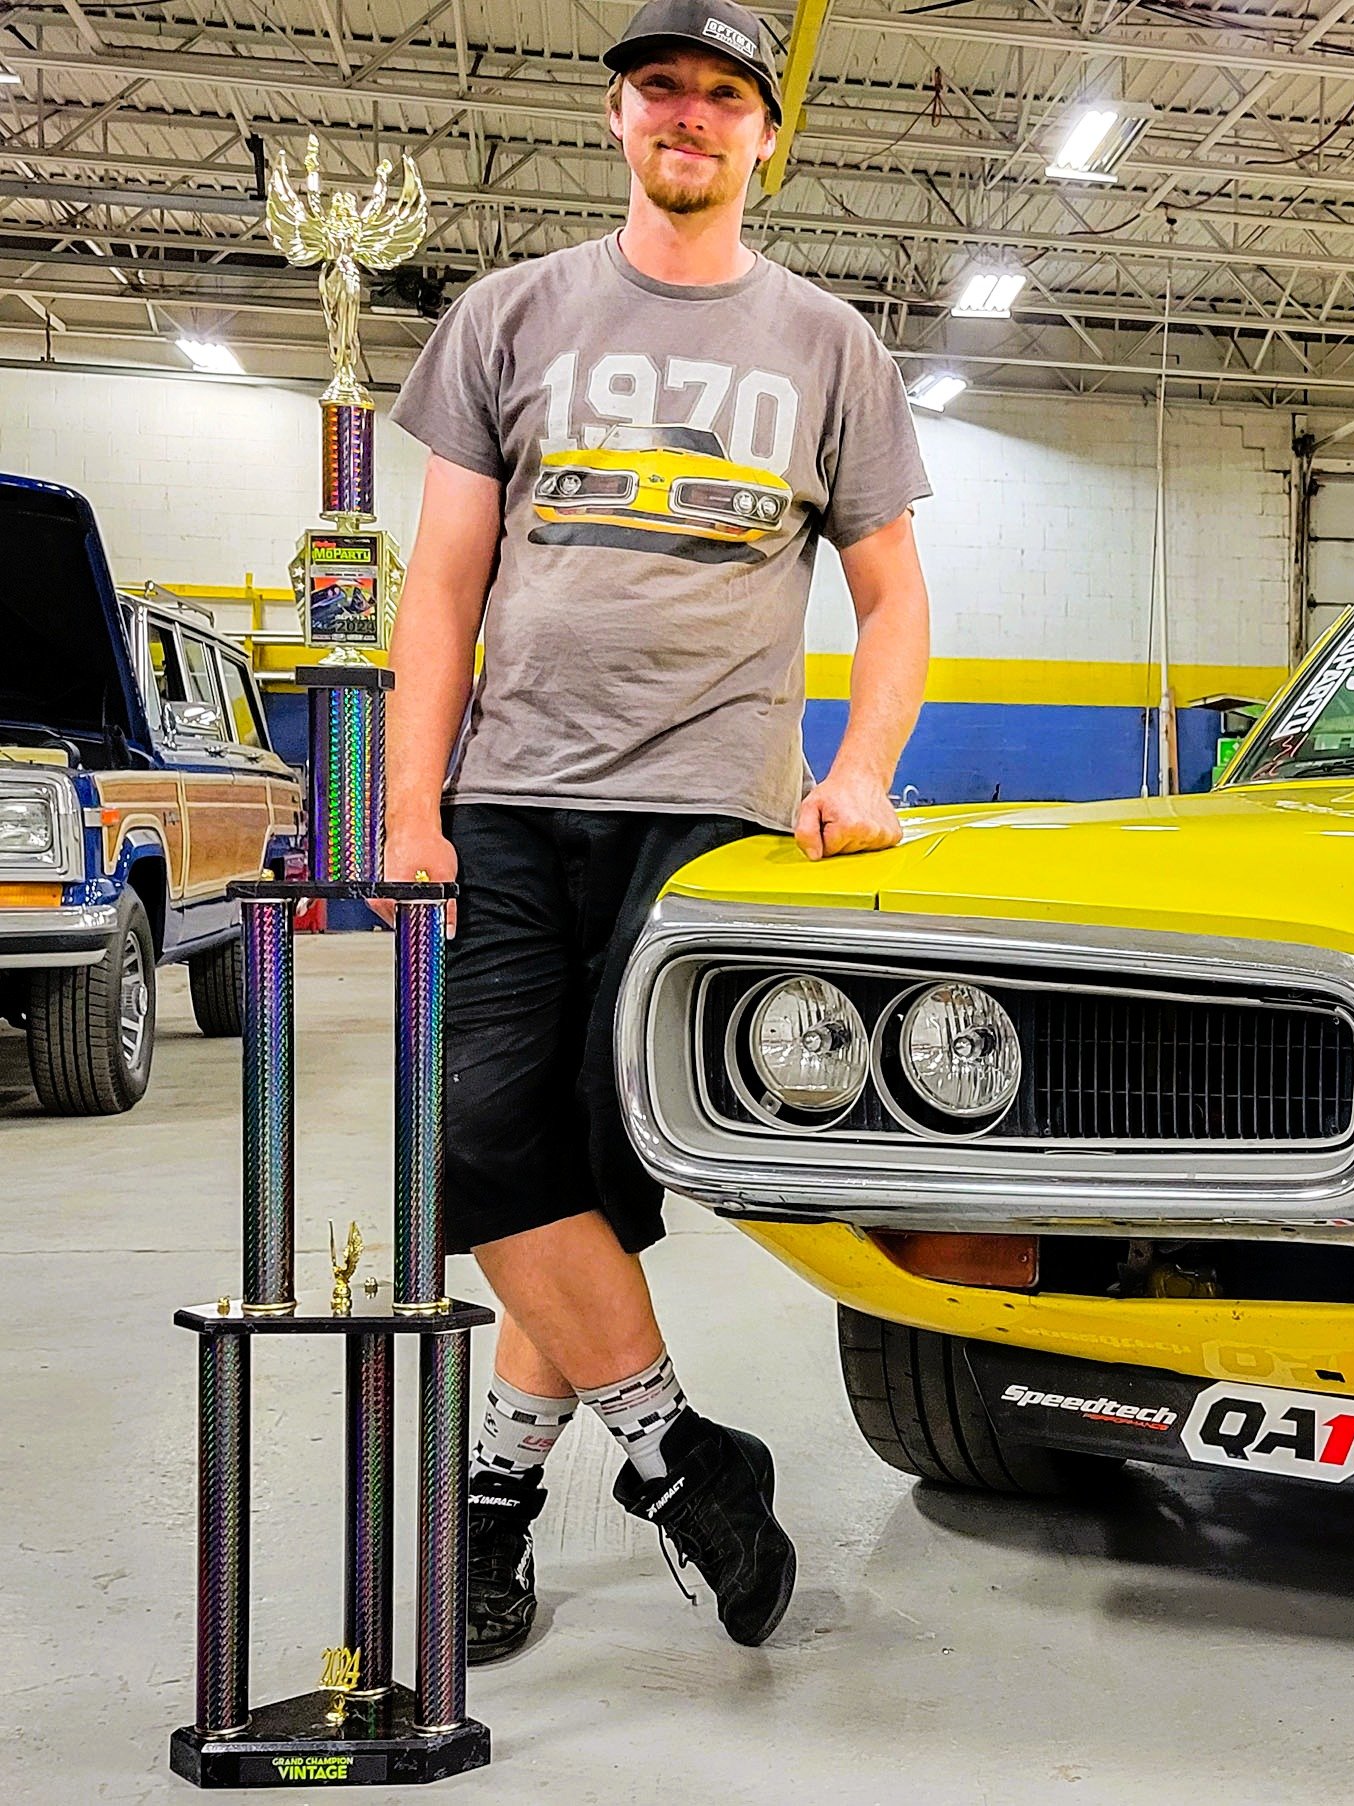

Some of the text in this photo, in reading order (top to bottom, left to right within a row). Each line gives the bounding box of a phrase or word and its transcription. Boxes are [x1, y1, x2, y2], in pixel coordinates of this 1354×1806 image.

[708, 20, 753, 52] OPTIMA
[539, 350, 799, 477] 1970
[1001, 1384, 1178, 1425] Speedtech
[479, 1496, 520, 1507] IMPACT
[656, 1477, 685, 1510] IMPACT
[320, 1647, 360, 1688] 2024
[271, 1756, 354, 1766] GRAND CHAMPION
[277, 1765, 348, 1780] VINTAGE
